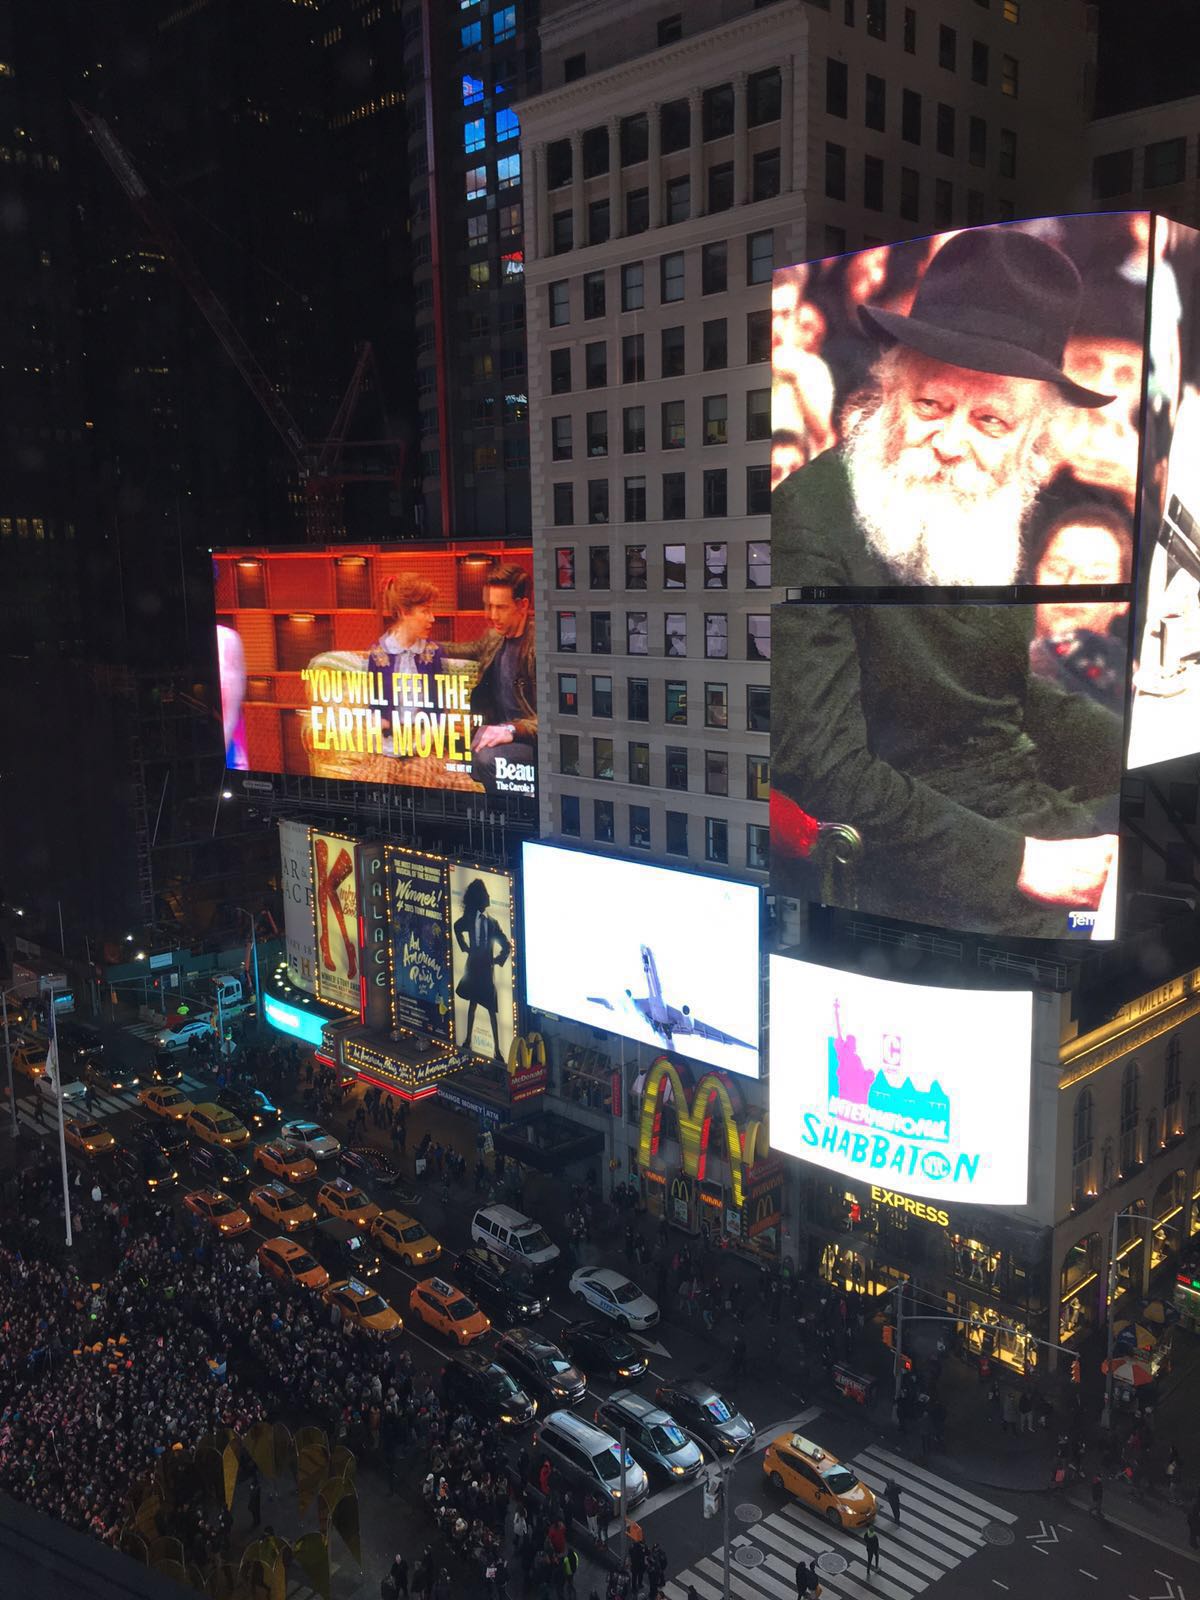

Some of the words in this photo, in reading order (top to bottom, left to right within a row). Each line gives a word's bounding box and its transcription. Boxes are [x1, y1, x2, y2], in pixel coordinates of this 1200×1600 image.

[346, 671, 388, 706] WILL
[392, 673, 434, 708] FEEL
[434, 674, 471, 710] THE
[311, 706, 382, 754] EARTH
[495, 757, 535, 781] Beau
[496, 781, 508, 790] The
[509, 782, 530, 793] Carole
[396, 879, 442, 907] Winner!
[371, 859, 386, 987] PALACE
[437, 1089, 461, 1105] CHANGE
[461, 1099, 482, 1113] MONEY
[485, 1111, 499, 1120] ATM
[802, 1112, 981, 1183] SHABBATON
[871, 1185, 950, 1227] EXPRESS
